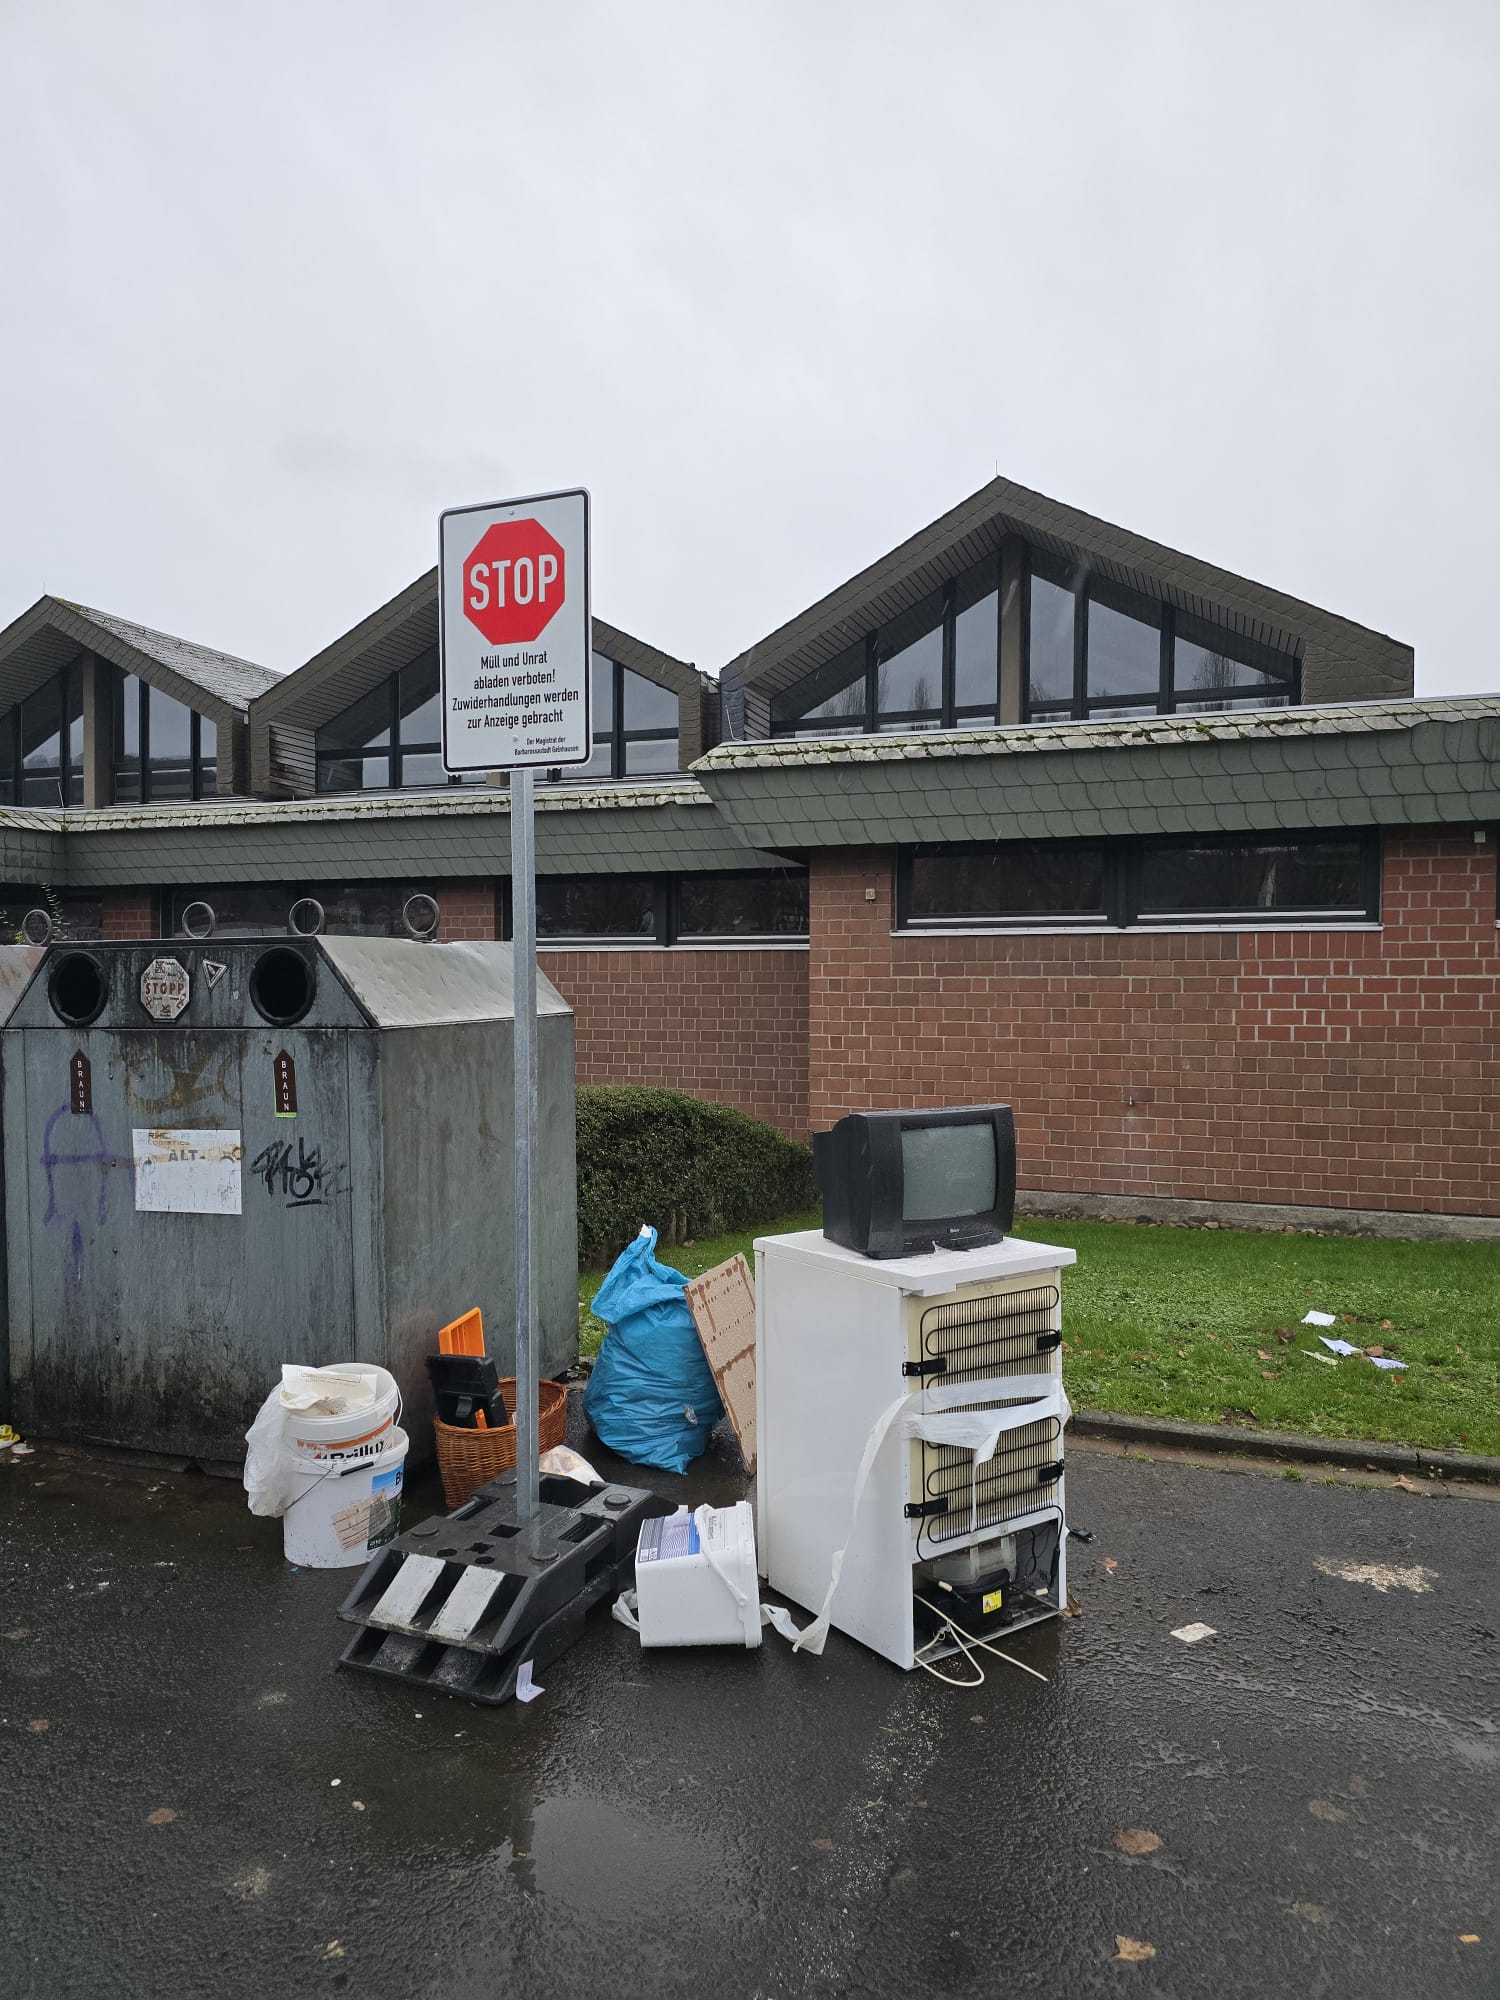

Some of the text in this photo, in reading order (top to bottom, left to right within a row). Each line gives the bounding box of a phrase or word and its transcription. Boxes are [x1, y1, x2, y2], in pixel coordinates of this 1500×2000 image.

[470, 554, 558, 610] STOP
[481, 650, 548, 670] Müll und Unrat
[473, 669, 556, 689] abladen verboten!
[452, 688, 579, 711] Zuwiderhandlungen werden
[467, 709, 564, 730] zur Anzeige gebracht
[526, 735, 566, 746] Der Magistrat der
[145, 982, 185, 995] STOPP
[77, 1060, 85, 1108] BRAUN
[281, 1060, 290, 1111] BRAUN
